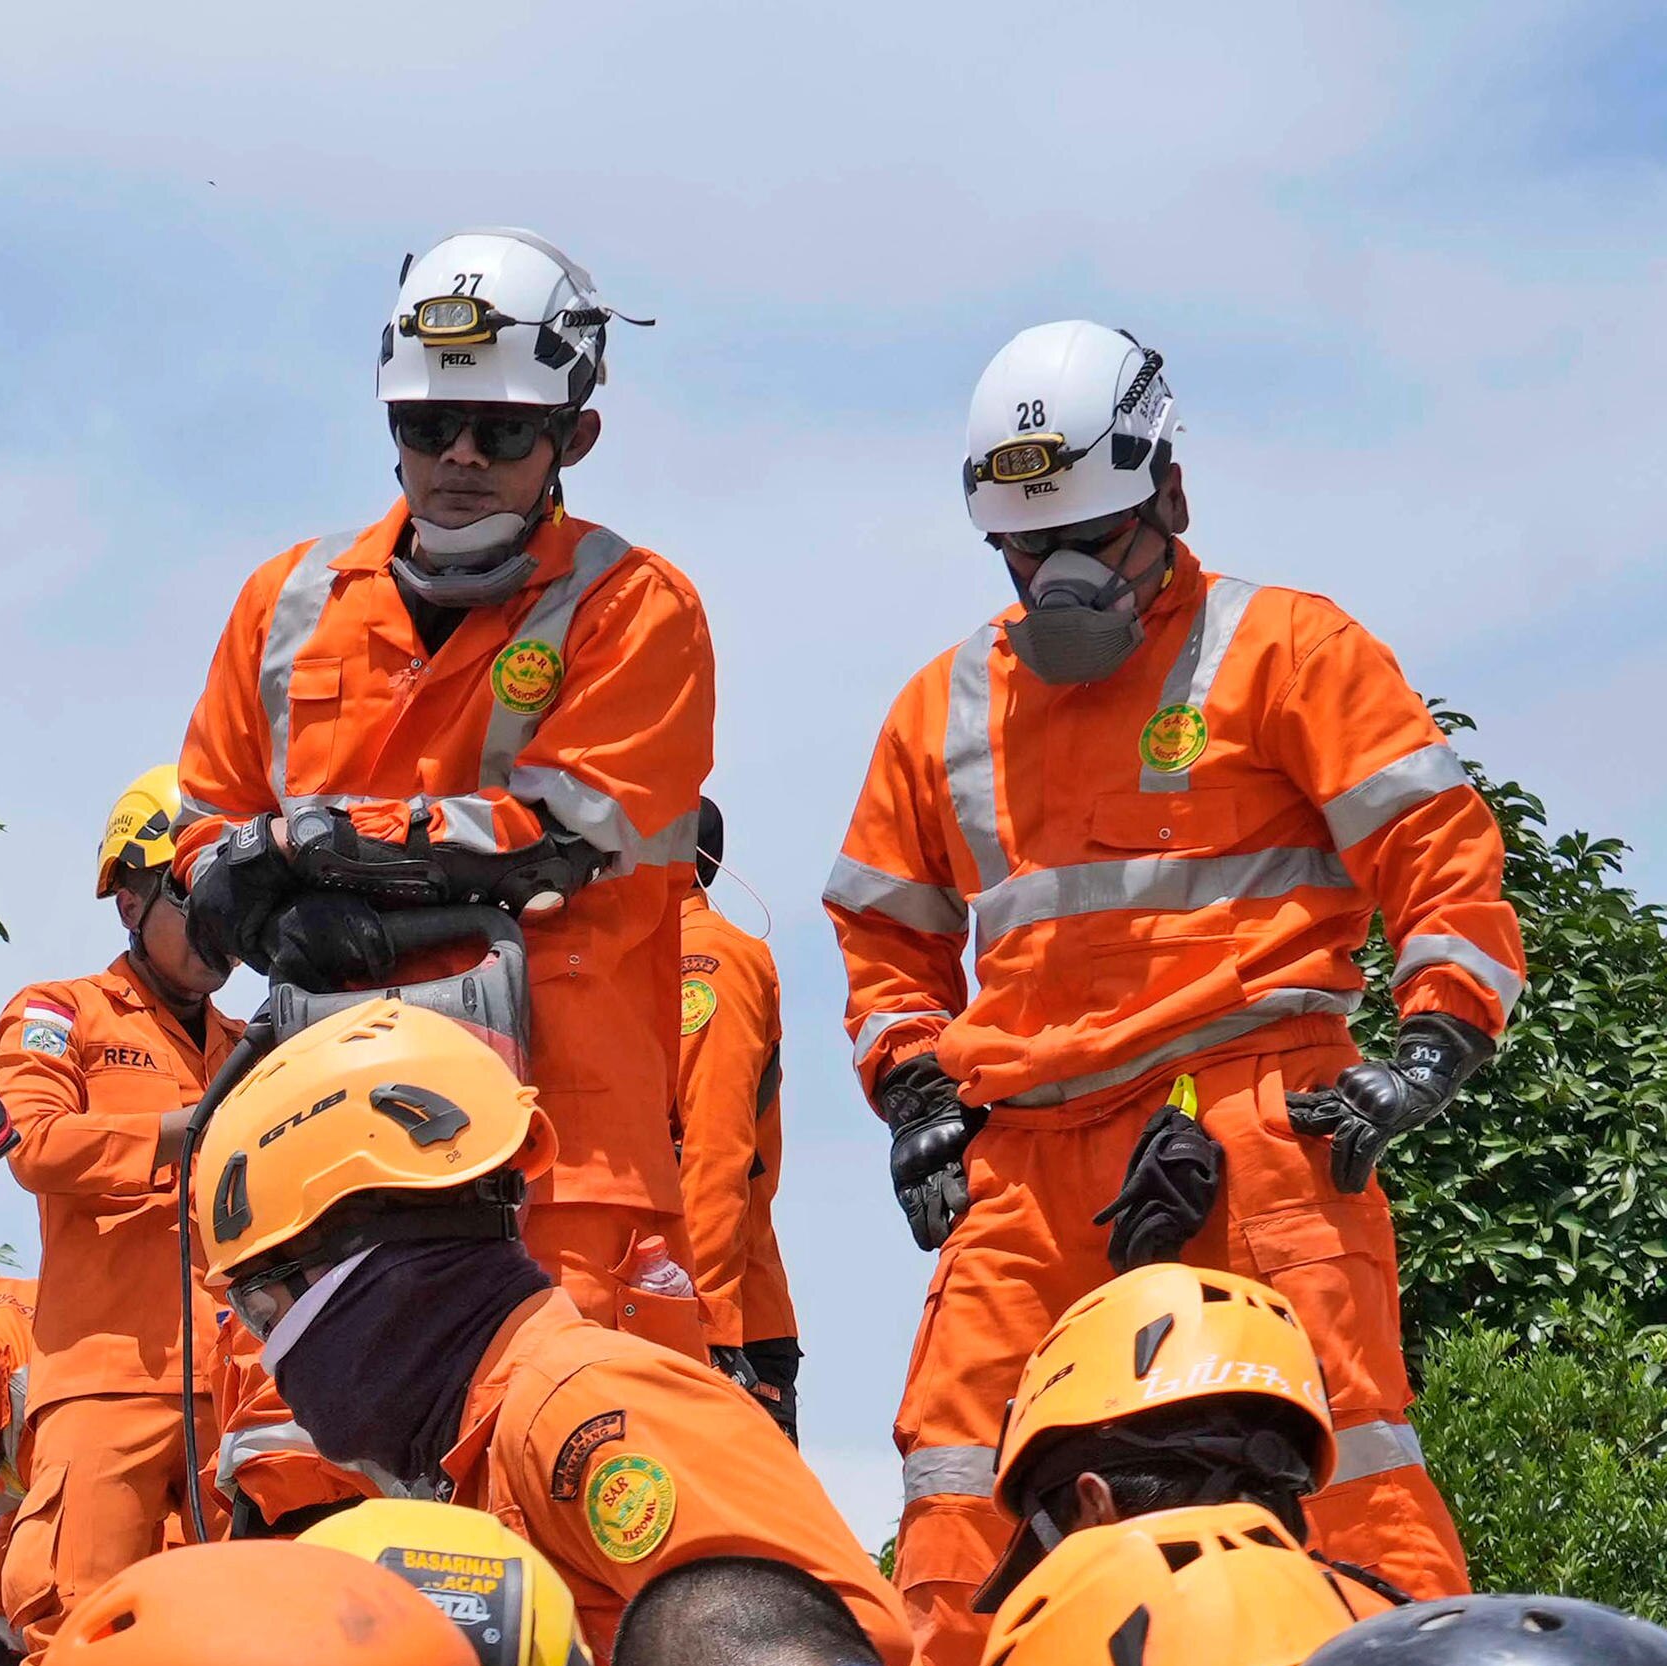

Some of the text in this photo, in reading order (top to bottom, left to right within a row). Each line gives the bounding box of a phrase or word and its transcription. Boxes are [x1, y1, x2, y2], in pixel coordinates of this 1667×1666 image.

[451, 273, 484, 296] 27
[440, 352, 477, 370] PETZL
[1017, 400, 1046, 431] 28
[1023, 481, 1061, 500] PETZL
[516, 652, 548, 670] SAR
[104, 1047, 157, 1070] REZA
[259, 1089, 347, 1149] GUB
[602, 1475, 629, 1508] SAR
[403, 1550, 505, 1579] BASARNAS
